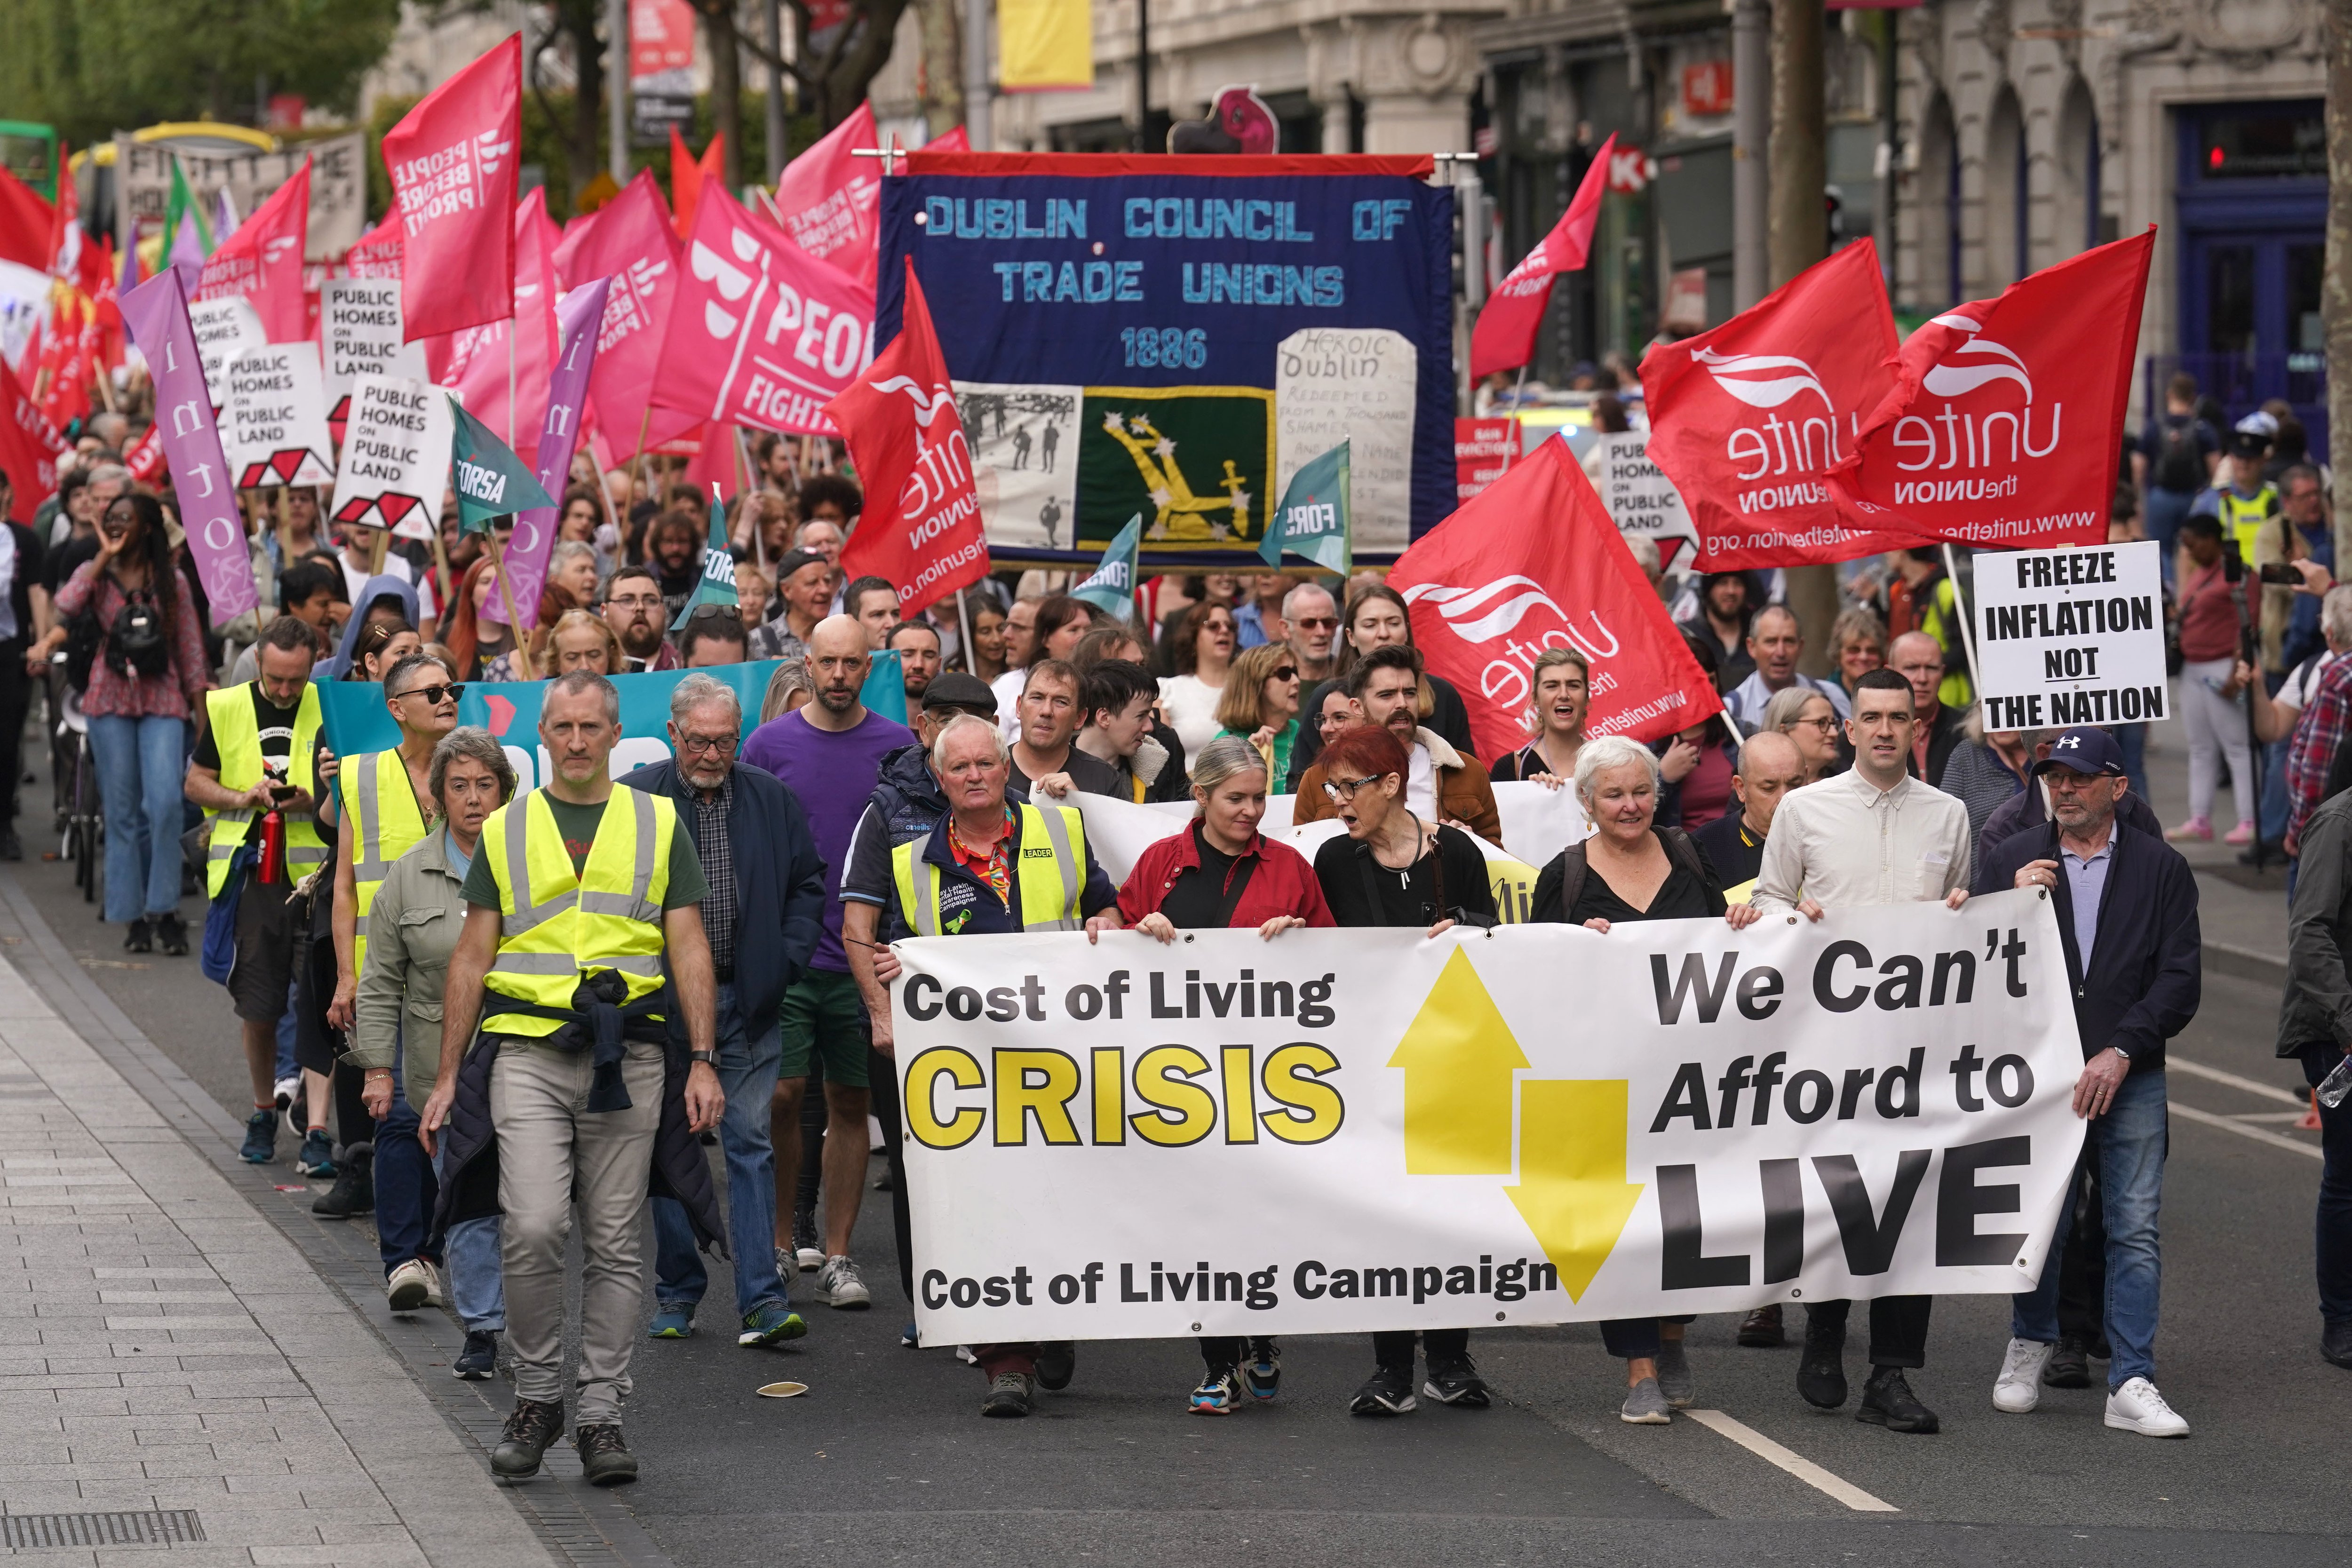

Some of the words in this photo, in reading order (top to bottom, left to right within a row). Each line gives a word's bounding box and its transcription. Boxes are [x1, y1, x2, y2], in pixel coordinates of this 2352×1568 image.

[925, 196, 1087, 239] DUBLIN
[1124, 198, 1313, 241] COUNCIL
[1352, 199, 1411, 240] OF
[993, 261, 1143, 303] TRADE
[1182, 262, 1343, 306] UNIONS
[333, 290, 395, 306] PUBLIC
[192, 307, 235, 326] UBLIC
[333, 310, 397, 325] HOMES
[196, 325, 239, 344] OMES
[334, 328, 351, 337] ON
[334, 342, 396, 358] PUBLIC
[1120, 327, 1207, 369] 1886
[230, 355, 289, 374] PUBLIC
[232, 375, 293, 394] HOMES
[234, 397, 250, 406] ON
[364, 386, 429, 411] PUBLIC
[743, 373, 839, 432] FIGHT
[236, 406, 295, 424] PUBLIC
[360, 406, 426, 431] HOMES
[238, 427, 285, 444] LAND
[358, 425, 375, 436] ON
[355, 439, 419, 465] PUBLIC
[350, 461, 401, 481] LAND
[1612, 462, 1664, 479] HOME
[1612, 482, 1630, 493] ON
[1613, 492, 1676, 511] PUBLIC
[1615, 515, 1664, 531] LAND
[2017, 551, 2116, 589] FREEZE
[1986, 596, 2153, 641] INFLATION
[2044, 647, 2100, 679] NOT
[1985, 694, 2043, 729] THE
[2050, 685, 2163, 724] NATION
[1024, 848, 1052, 858] LEADER
[939, 891, 953, 902] ental
[953, 886, 975, 896] Health
[947, 883, 969, 892] Larkin
[939, 892, 974, 907] Awareness
[939, 897, 977, 913] Campaigner
[1649, 951, 1785, 1026] We
[903, 973, 1046, 1023] Cost
[1065, 970, 1130, 1021] of
[1149, 969, 1336, 1028] Living
[904, 1042, 1345, 1151] CRISIS
[1648, 1046, 1926, 1133] Afford
[1948, 1044, 2035, 1113] to
[1656, 1134, 2031, 1291] LIVE
[921, 1266, 1033, 1310] Cost
[1048, 1262, 1104, 1305] of
[1120, 1262, 1278, 1311] Living
[1293, 1254, 1557, 1305] Campaign
